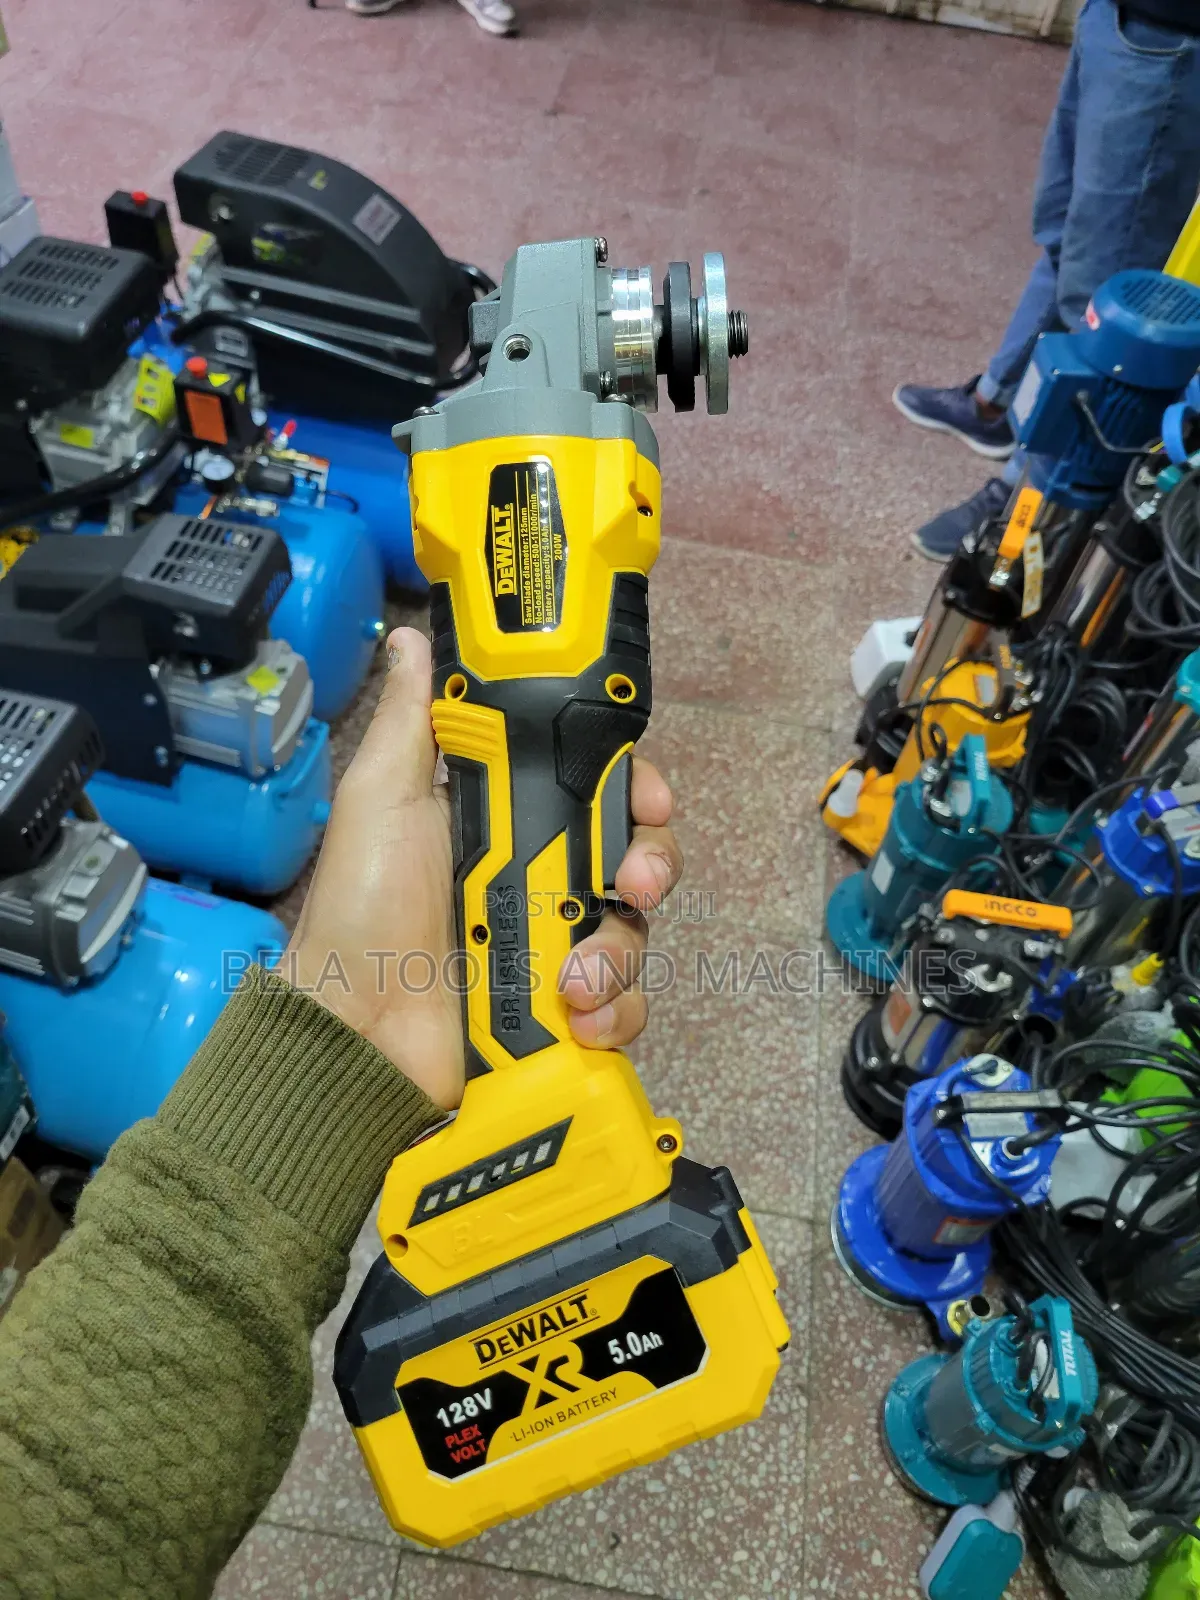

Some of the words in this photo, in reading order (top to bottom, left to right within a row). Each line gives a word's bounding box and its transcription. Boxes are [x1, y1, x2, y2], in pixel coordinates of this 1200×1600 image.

[521, 507, 530, 579] diameter:125mm
[553, 533, 563, 560] 200W
[523, 580, 531, 604] blade
[534, 589, 543, 624] No-load
[544, 591, 553, 623] Battery
[608, 1330, 664, 1366] 5.0Ah
[436, 1387, 493, 1428] 128V
[559, 1388, 618, 1423] BATTERY
[445, 1424, 481, 1449] PLEX
[450, 1438, 486, 1465] VOLT
